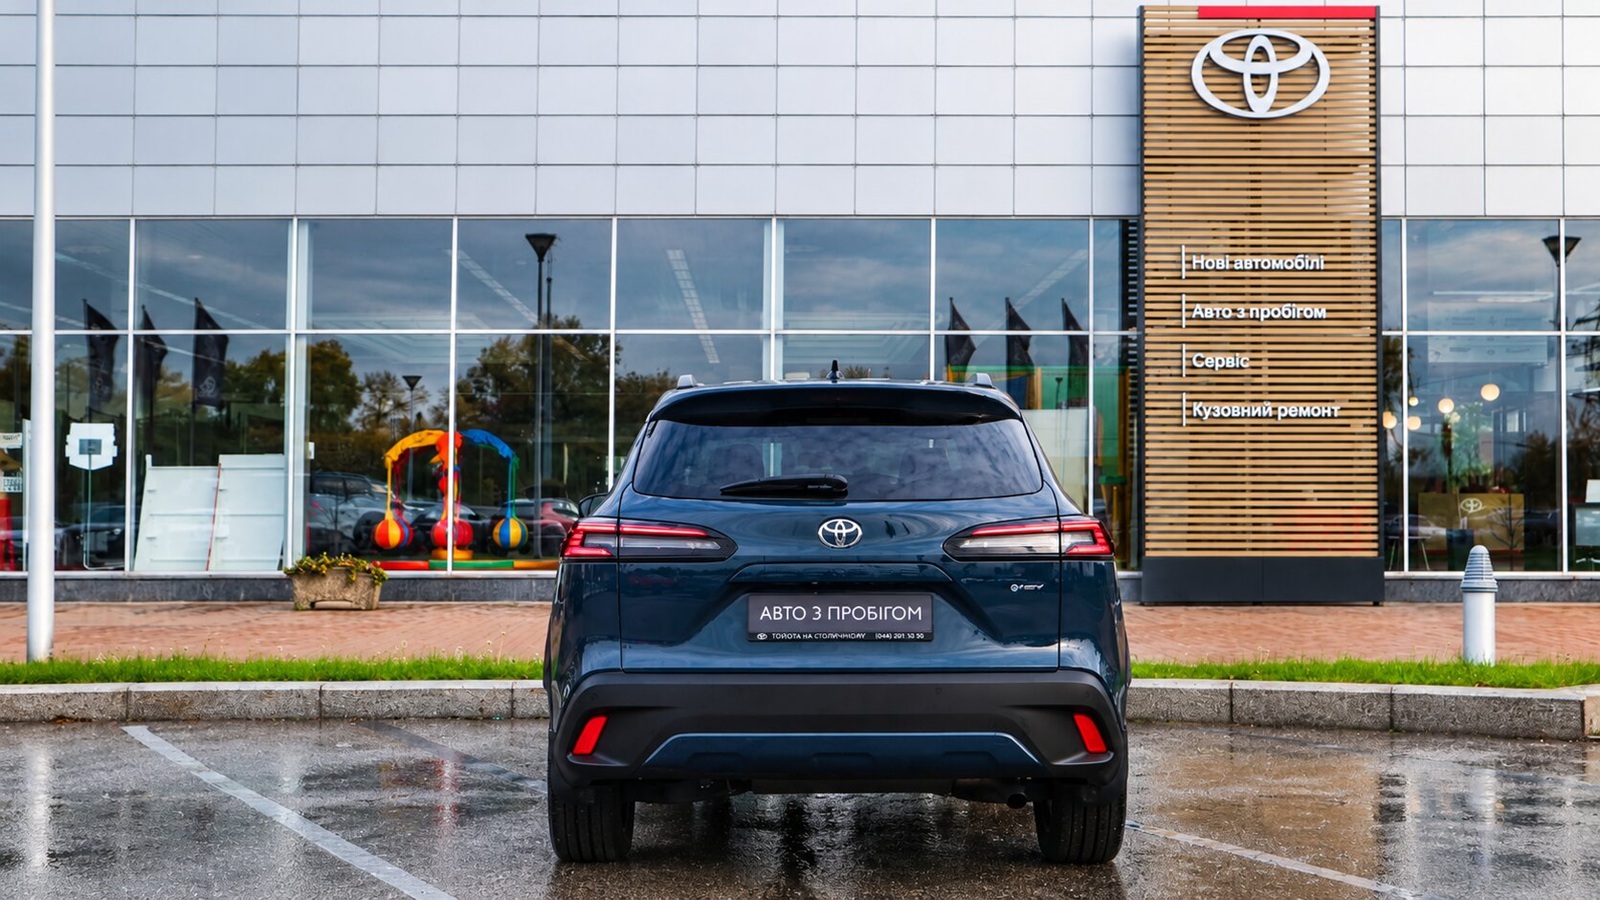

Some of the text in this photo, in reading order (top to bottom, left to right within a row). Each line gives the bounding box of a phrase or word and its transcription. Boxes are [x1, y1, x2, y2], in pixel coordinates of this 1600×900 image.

[1192, 254, 1325, 270] Нові автомобілі
[1192, 303, 1327, 321] Авто з пробігом
[1192, 353, 1250, 370] Сервіс
[1192, 401, 1340, 420] Кузовний ремонт
[760, 606, 806, 621] АВТО
[828, 606, 922, 621] ПРОБІГОМ
[802, 632, 813, 640] НА
